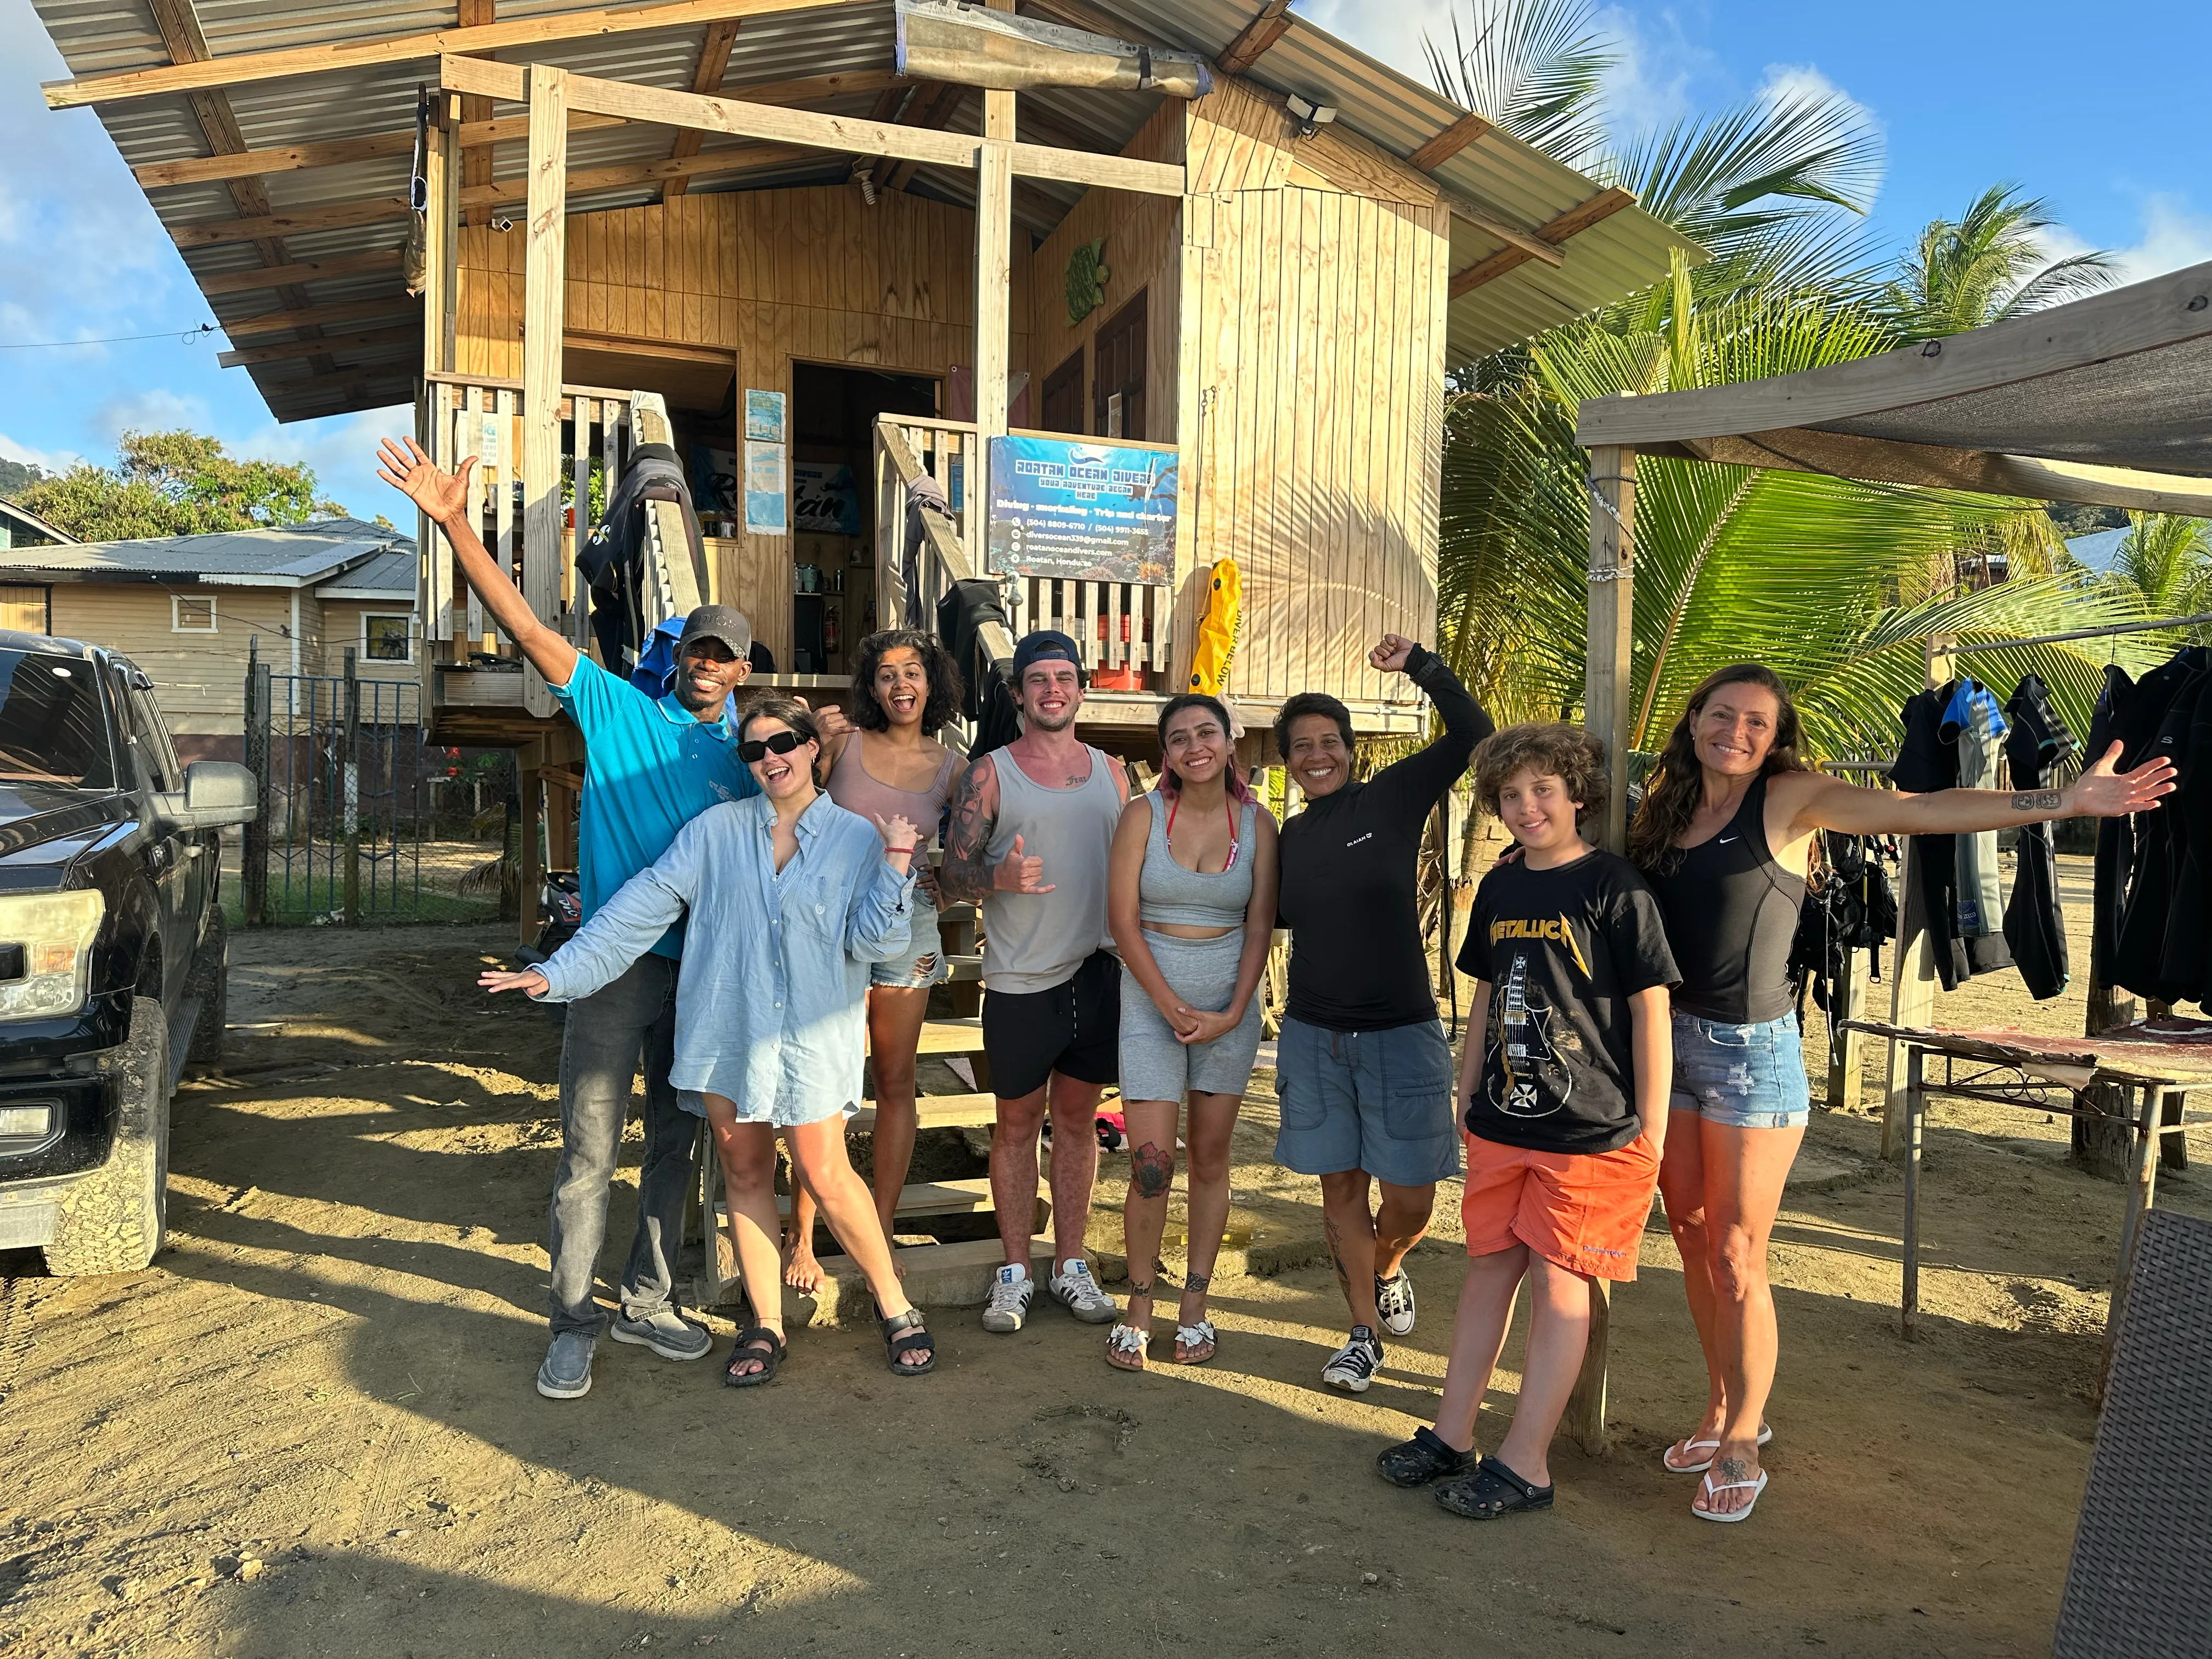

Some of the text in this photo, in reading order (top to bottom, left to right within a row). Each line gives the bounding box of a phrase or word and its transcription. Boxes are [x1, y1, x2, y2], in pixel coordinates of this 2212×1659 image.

[1017, 461, 1153, 486] ROATAN OCEAN DIVER
[1040, 478, 1132, 494] YOUR ADVENTURE BEGAN
[1076, 491, 1096, 499] HERE
[996, 499, 1029, 511] Diving
[1035, 504, 1088, 516] snorkeling
[1093, 507, 1115, 518] Trip
[1116, 511, 1135, 519] and
[1135, 513, 1171, 522] charter
[1026, 518, 1149, 536] (504) 8809-6710 / (504) 9911-3655
[1026, 531, 1129, 546] diversocean339@gmail.com
[1026, 544, 1113, 556] roatanoceandivers.com
[1026, 555, 1054, 566] Roatan,
[1216, 608, 1242, 687] DIVER BELOW
[1489, 910, 1593, 981] METALLICA
